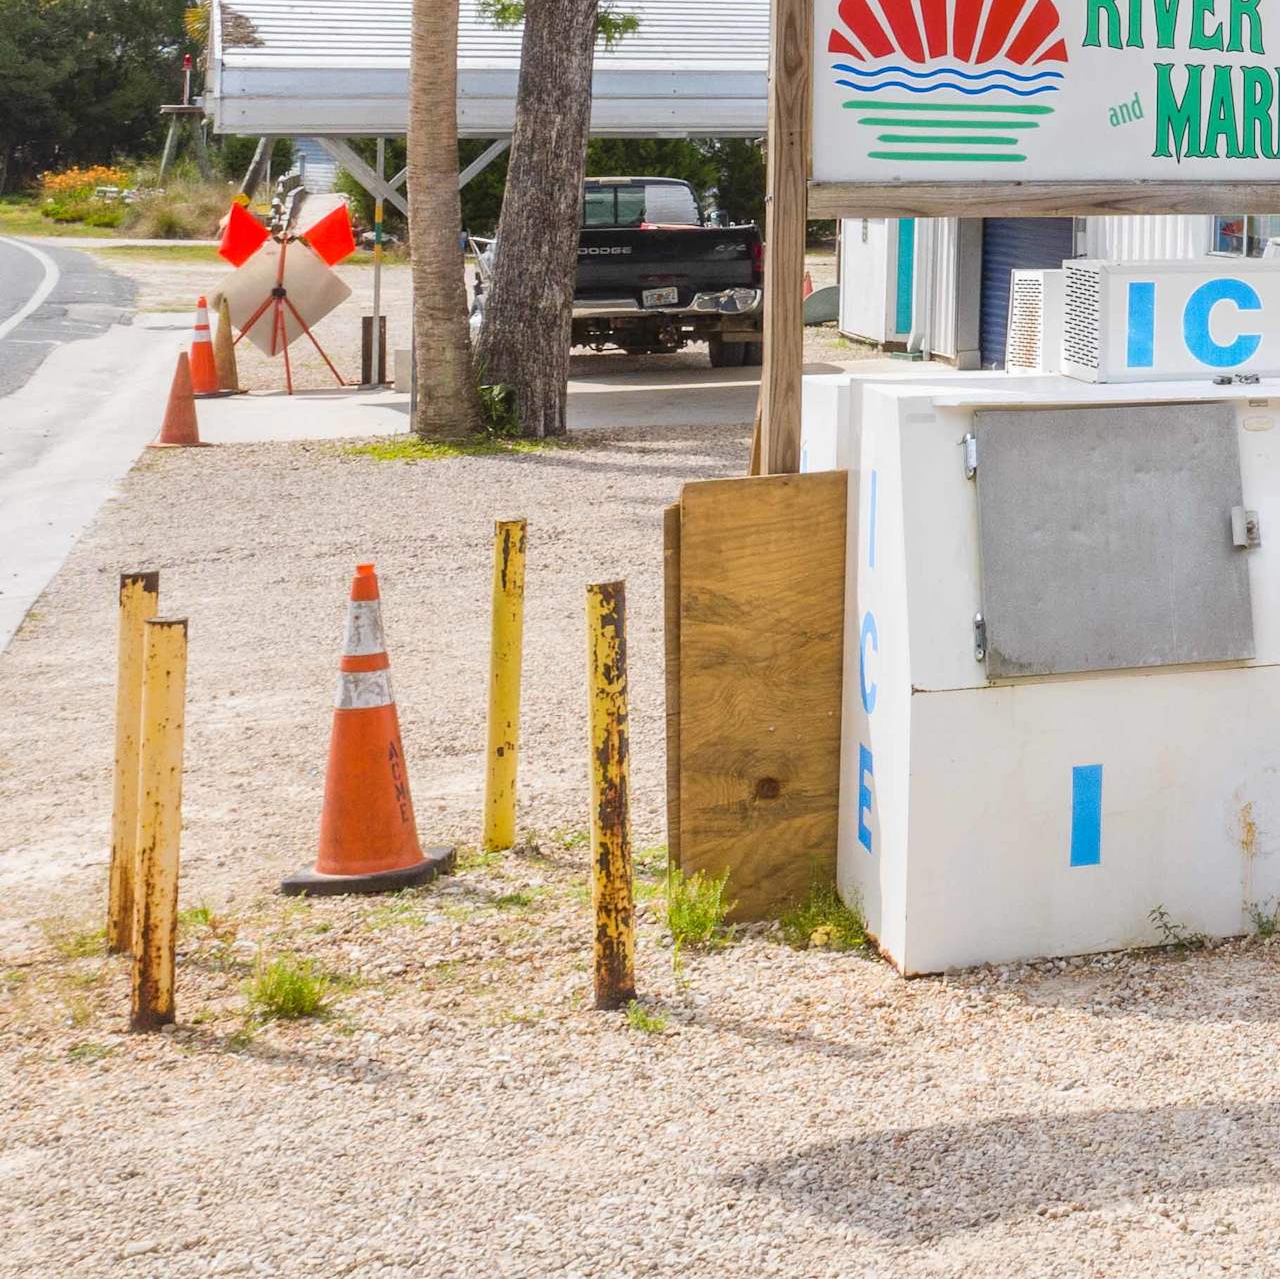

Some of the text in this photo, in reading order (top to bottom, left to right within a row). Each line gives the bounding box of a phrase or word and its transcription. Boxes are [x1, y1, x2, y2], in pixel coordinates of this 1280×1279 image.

[1109, 92, 1145, 128] and
[577, 246, 632, 255] DODGE
[858, 469, 878, 854] ICE
[388, 741, 409, 824] ACME
